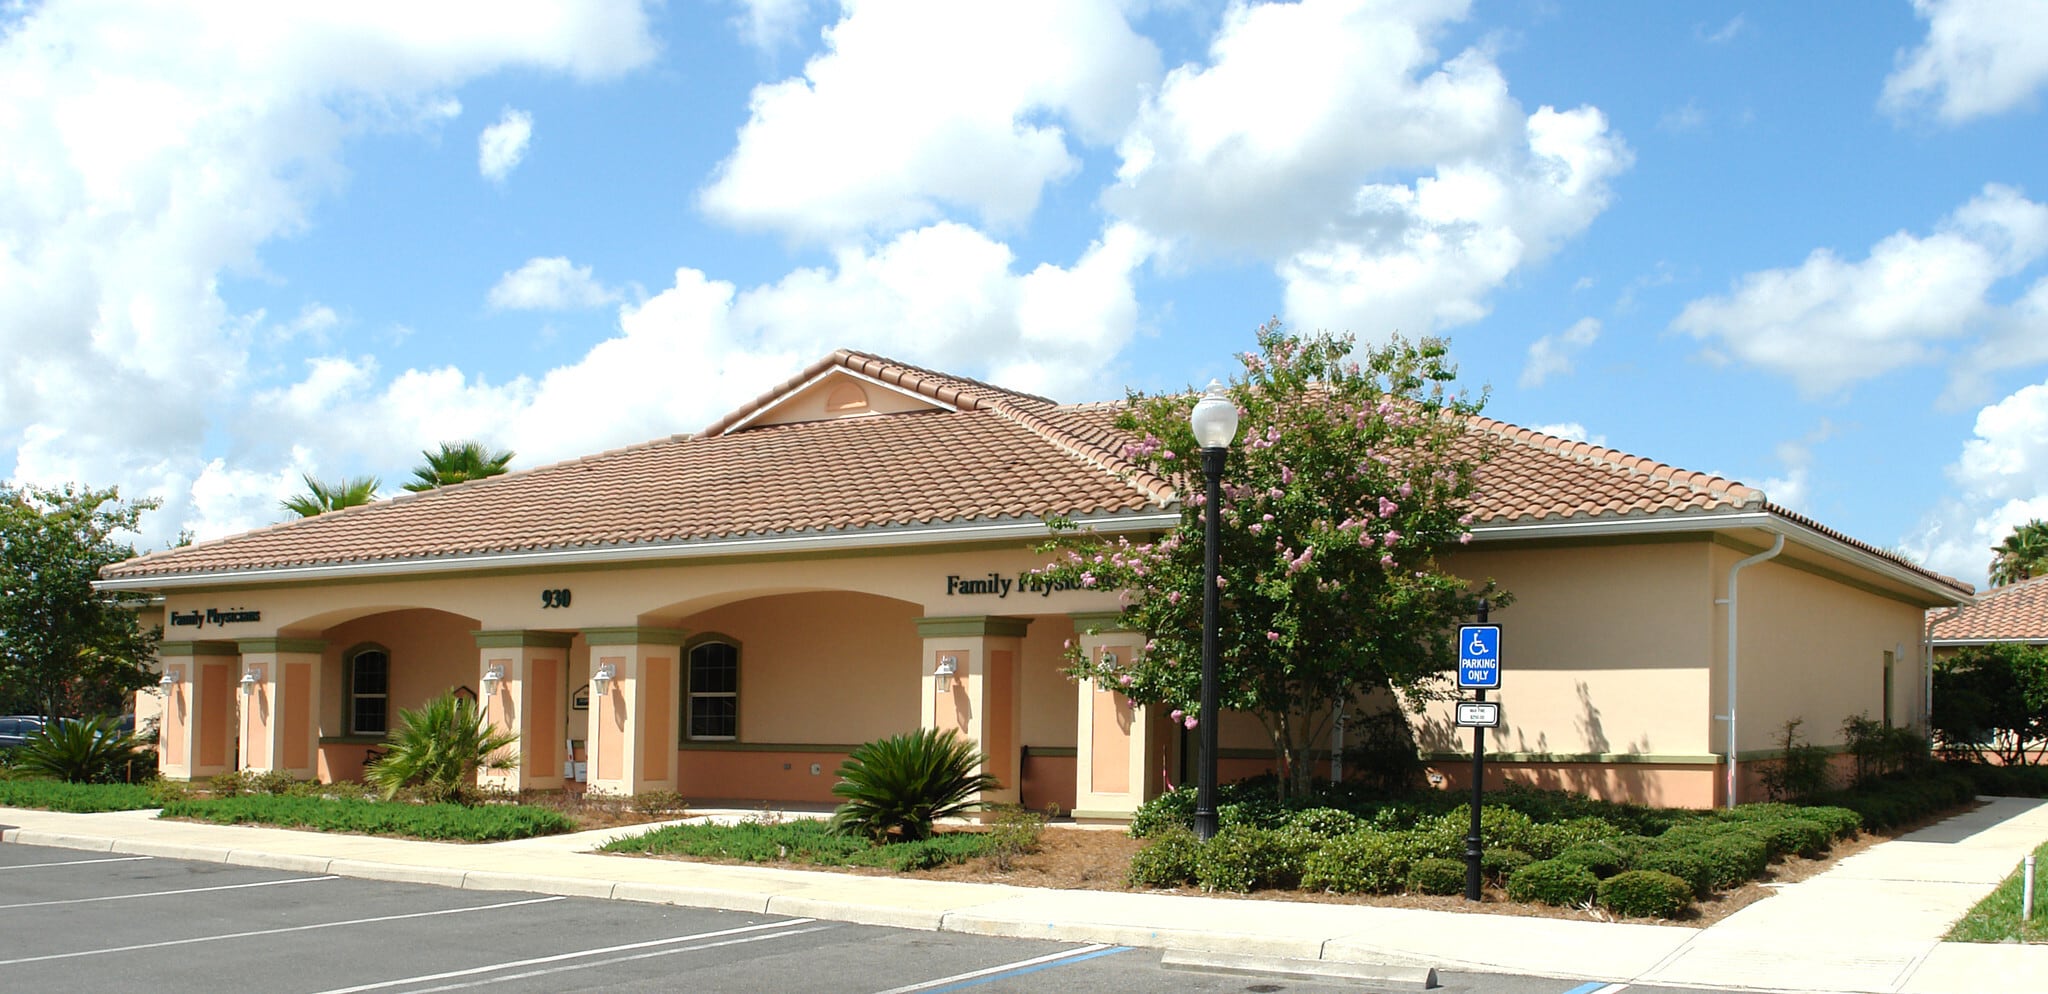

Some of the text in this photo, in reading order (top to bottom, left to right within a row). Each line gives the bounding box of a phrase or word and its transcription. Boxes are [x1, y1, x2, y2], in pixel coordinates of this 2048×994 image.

[947, 573, 1012, 598] Family
[542, 588, 572, 609] 930
[171, 607, 261, 629] Family Physicians
[1462, 659, 1496, 669] PARKING
[1468, 670, 1489, 681] ONLY
